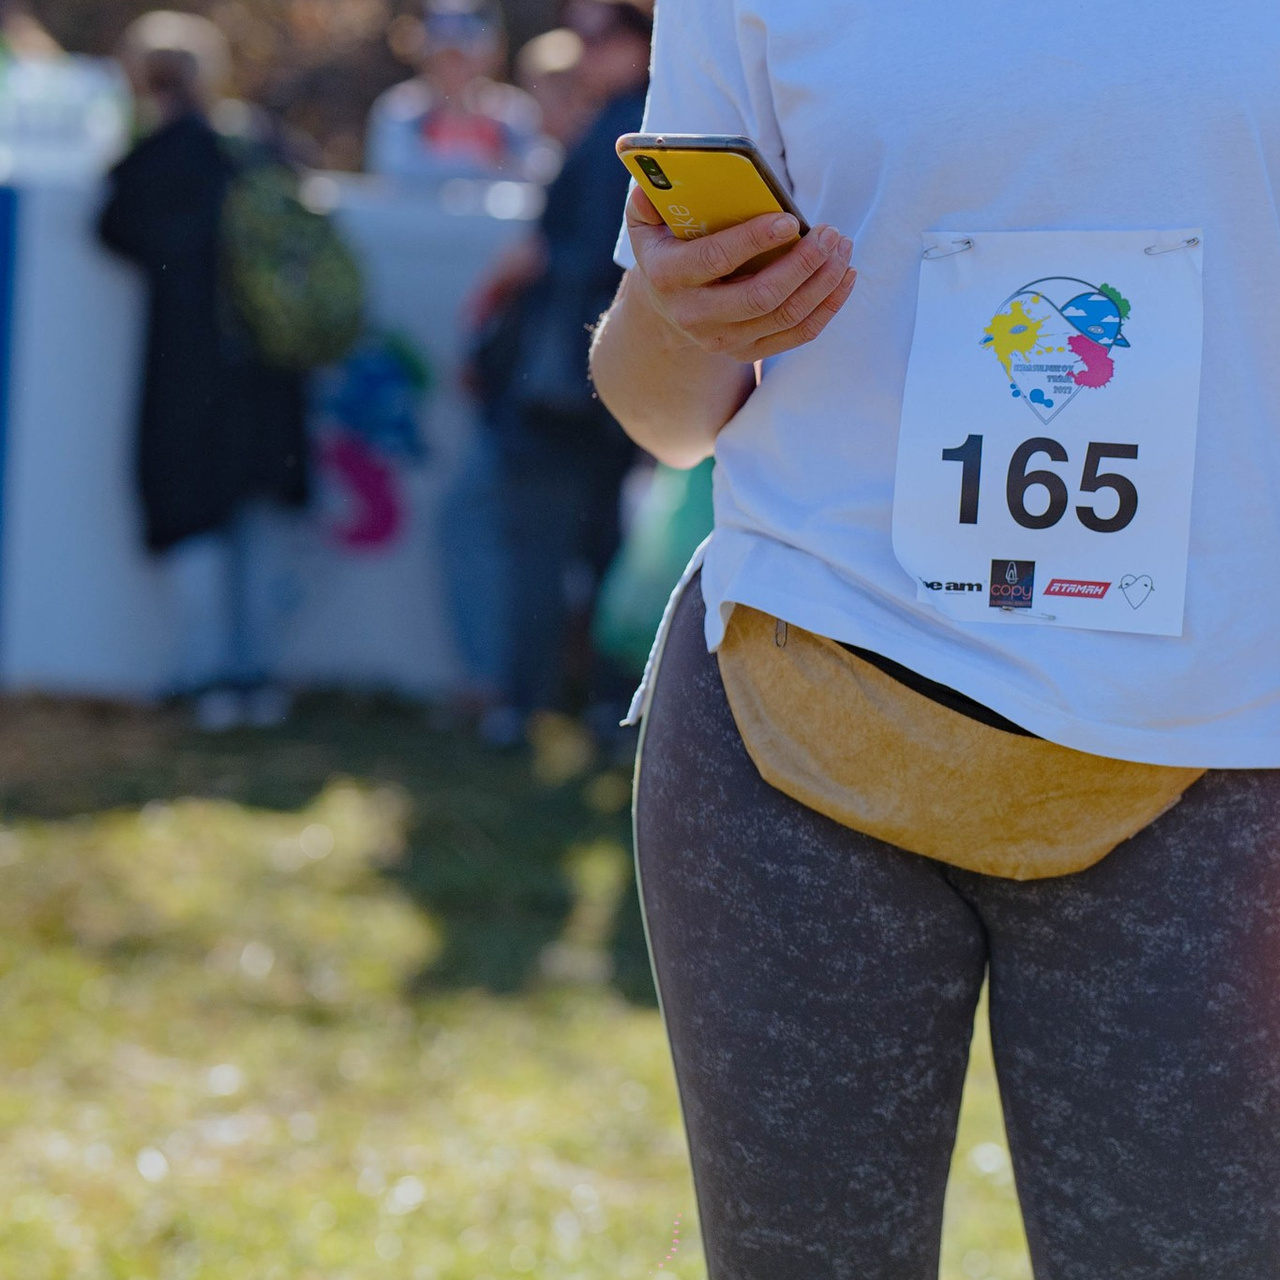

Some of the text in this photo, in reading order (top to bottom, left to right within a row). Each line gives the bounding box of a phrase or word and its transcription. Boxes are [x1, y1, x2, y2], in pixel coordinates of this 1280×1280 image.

[668, 204, 703, 240] ake
[942, 434, 1139, 533] 165
[990, 584, 1032, 600] copy
